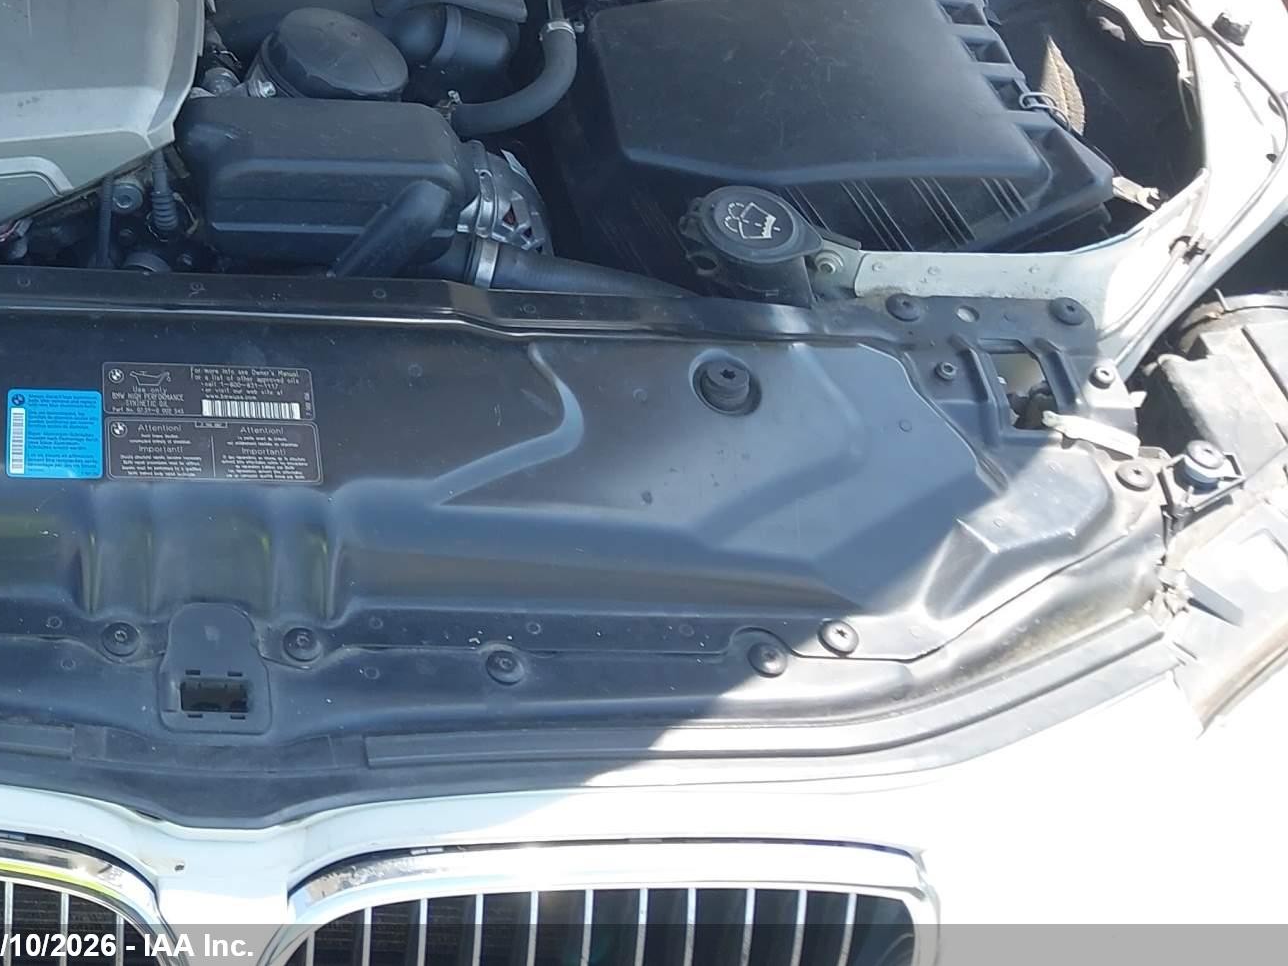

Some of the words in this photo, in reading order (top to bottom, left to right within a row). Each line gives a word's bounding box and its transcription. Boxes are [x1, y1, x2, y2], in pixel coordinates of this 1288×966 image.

[151, 386, 167, 394] only
[112, 392, 125, 400] BMW
[128, 392, 141, 400] HIGH
[144, 393, 184, 402] PERFORMANCE
